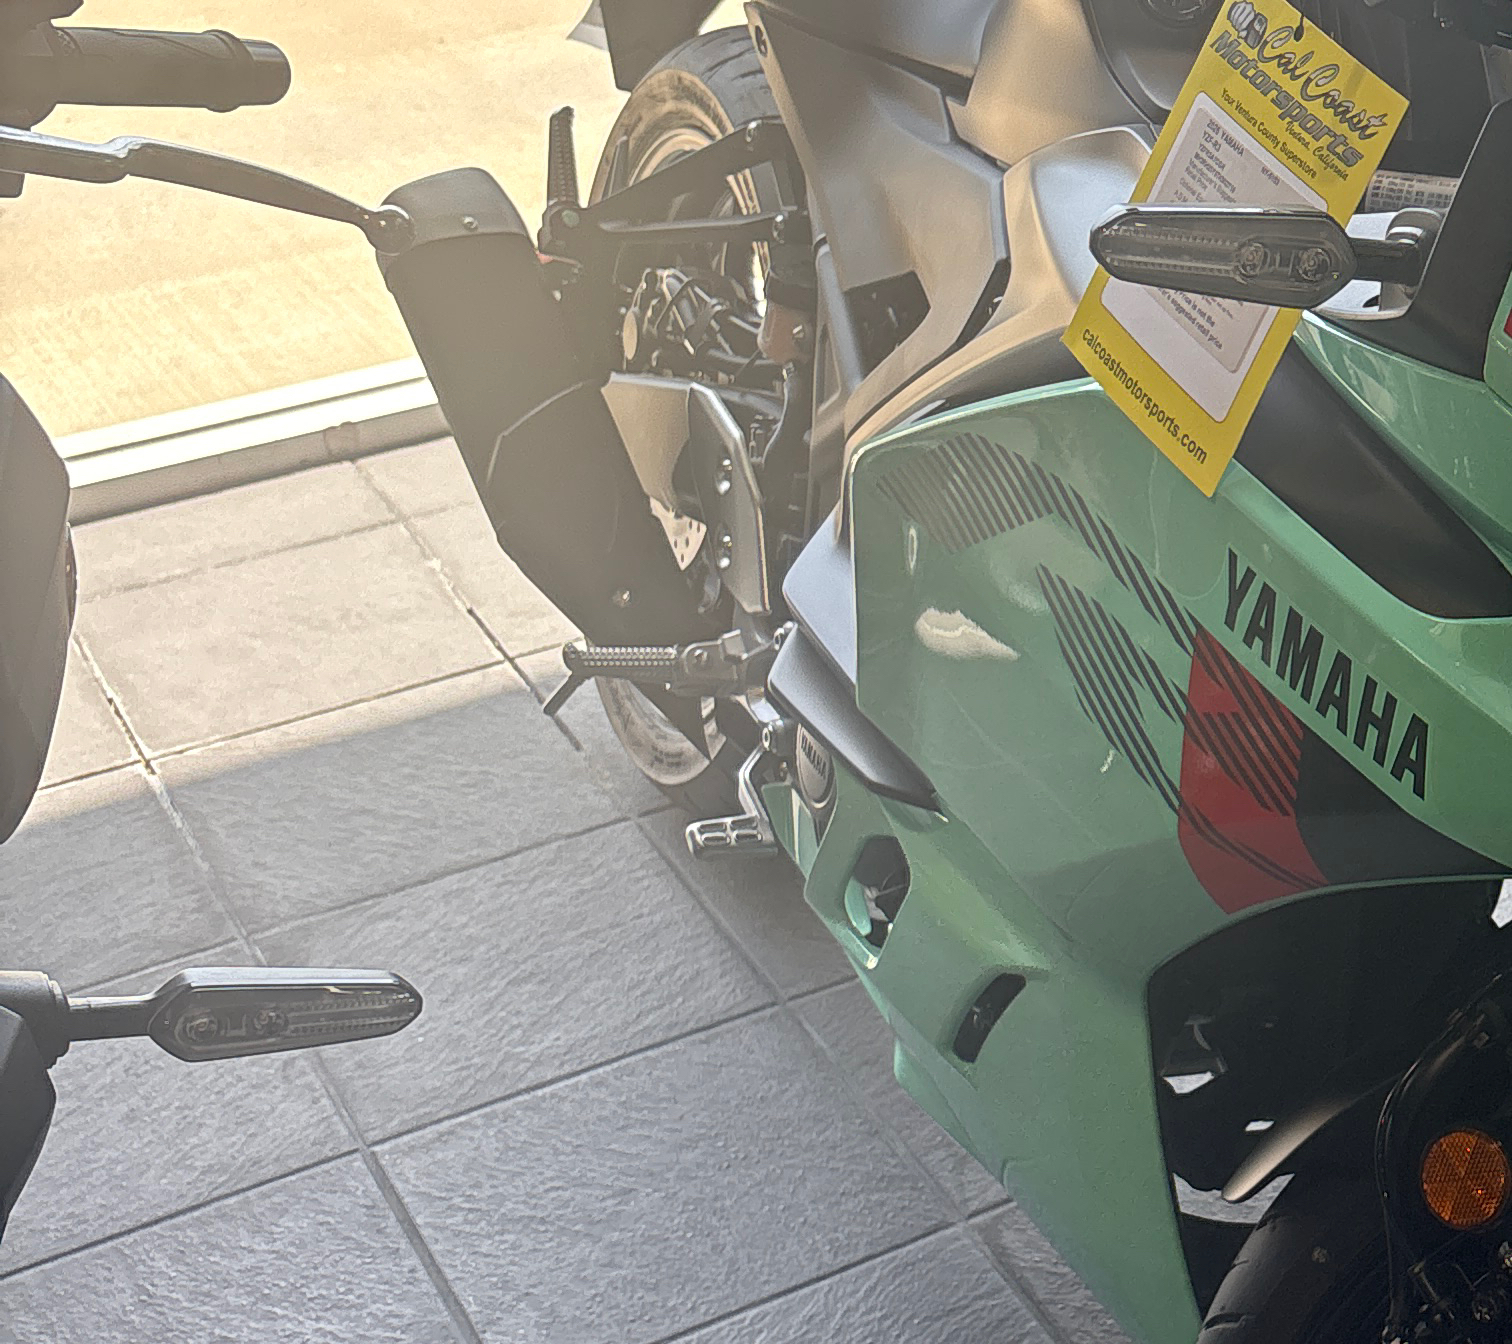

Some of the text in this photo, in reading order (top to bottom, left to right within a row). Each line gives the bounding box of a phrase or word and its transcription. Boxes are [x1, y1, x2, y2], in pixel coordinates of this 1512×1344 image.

[1209, 30, 1364, 167] Motorsports
[1221, 88, 1317, 179] Your Ventura County Superstore
[1257, 26, 1388, 140] Cal Coast
[1221, 129, 1246, 157] YAMAHA
[1312, 145, 1349, 181] California
[1081, 325, 1209, 466] calcoastmotorsports.com
[1224, 546, 1430, 802] YAMAHA
[801, 730, 827, 780] YAMAHA
